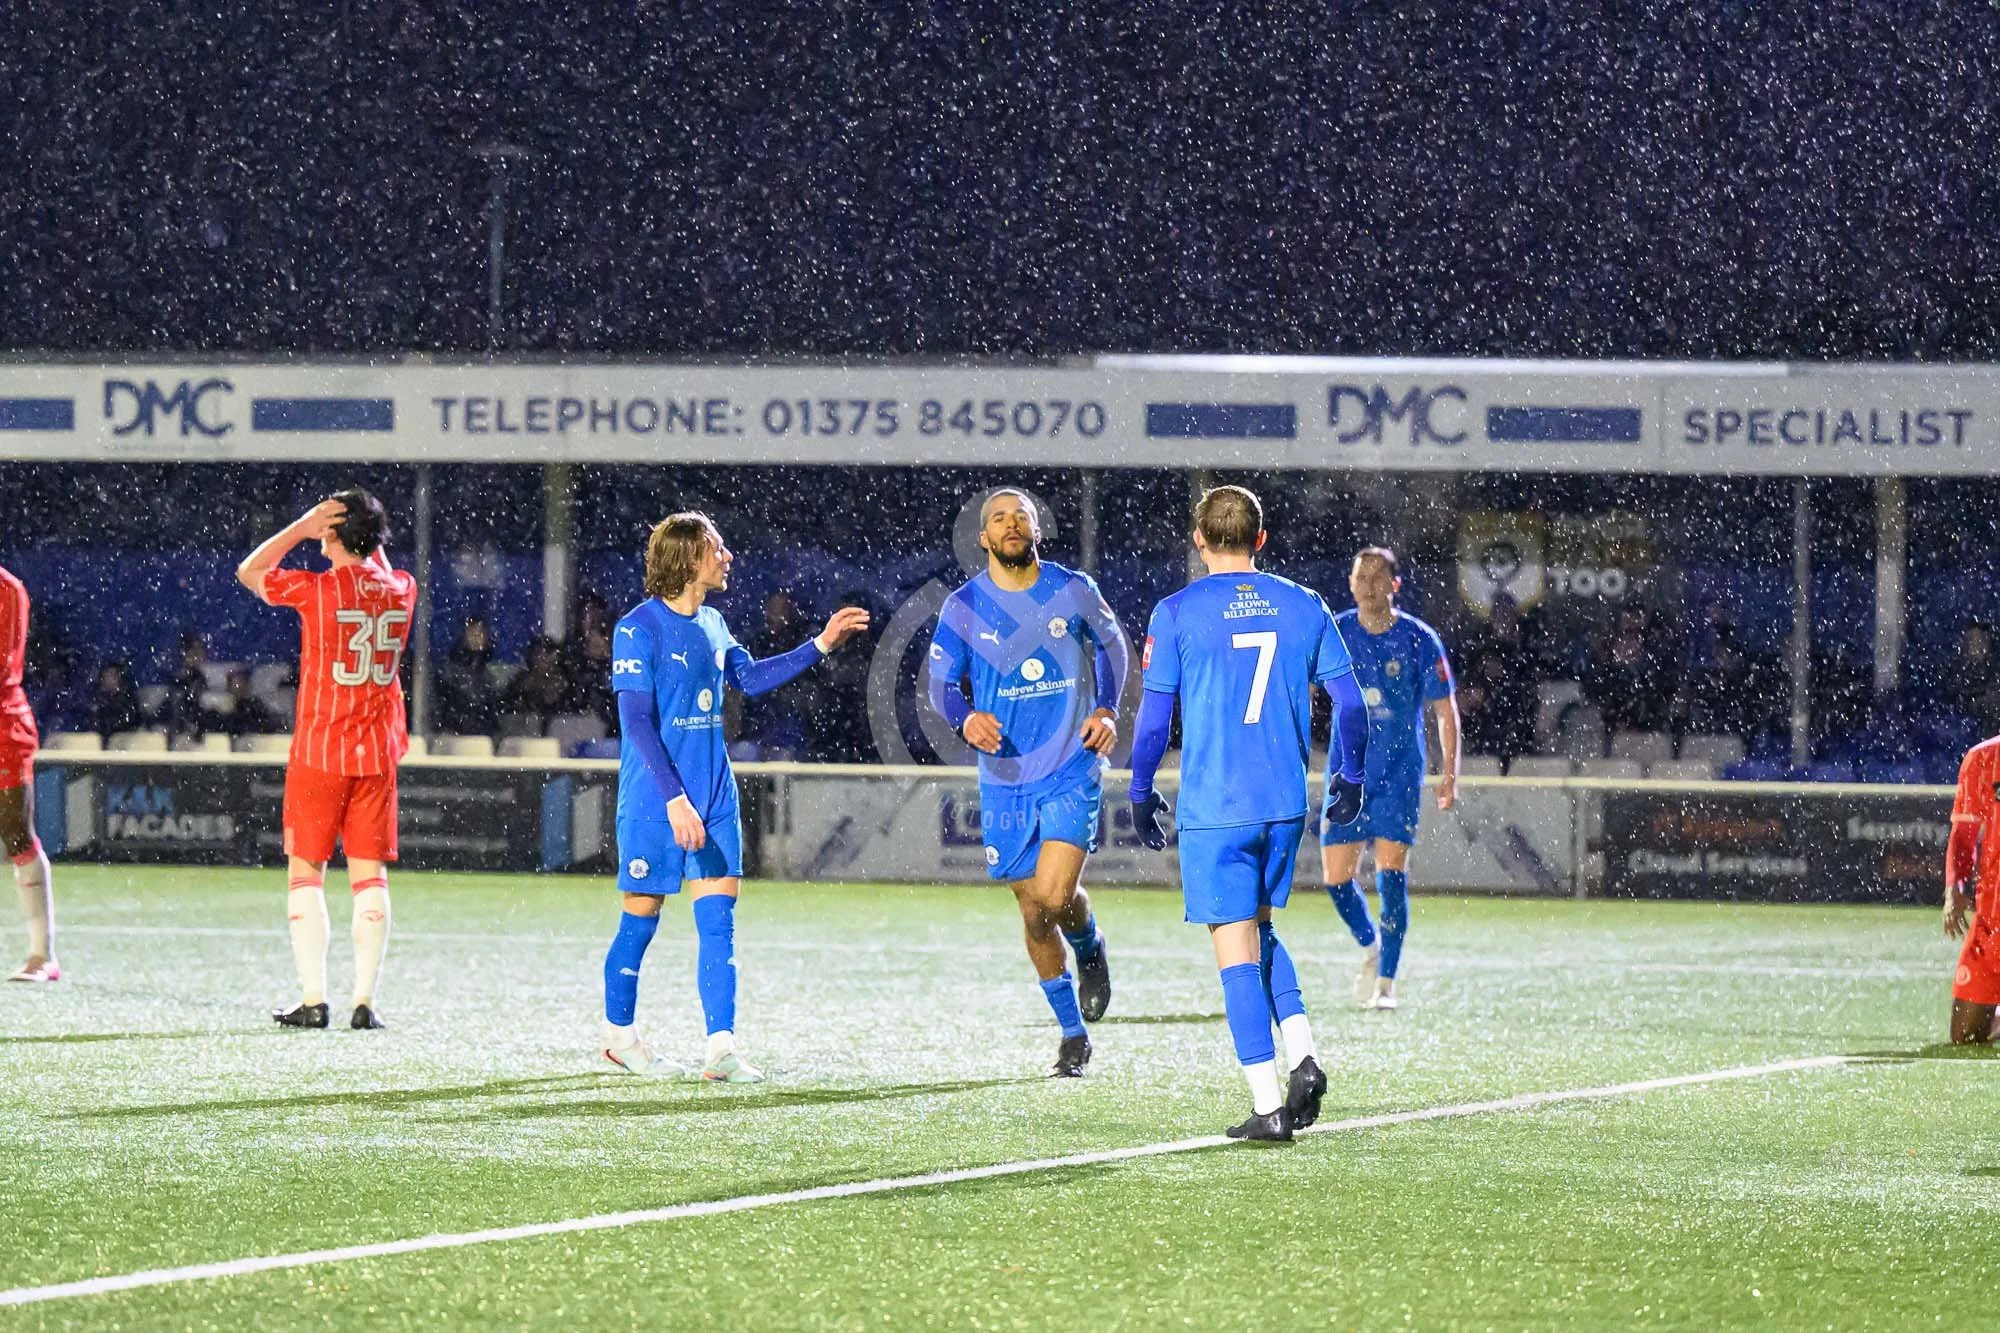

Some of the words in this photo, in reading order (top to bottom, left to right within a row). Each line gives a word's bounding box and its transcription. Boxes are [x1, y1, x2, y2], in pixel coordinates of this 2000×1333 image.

[104, 379, 234, 436] DMC
[431, 397, 744, 433] TELEPHONE:
[762, 399, 901, 436] 01375
[918, 400, 1106, 437] 845070
[1328, 384, 1467, 445] DMC
[1684, 409, 1974, 446] SPECIALIST
[1223, 607, 1279, 620] BILLERICAY
[1229, 600, 1271, 611] CROWN
[1236, 592, 1260, 601] THE
[331, 609, 408, 686] 35
[997, 684, 1034, 697] Andrew
[1035, 678, 1076, 692] Skinner
[1231, 631, 1278, 725] 7
